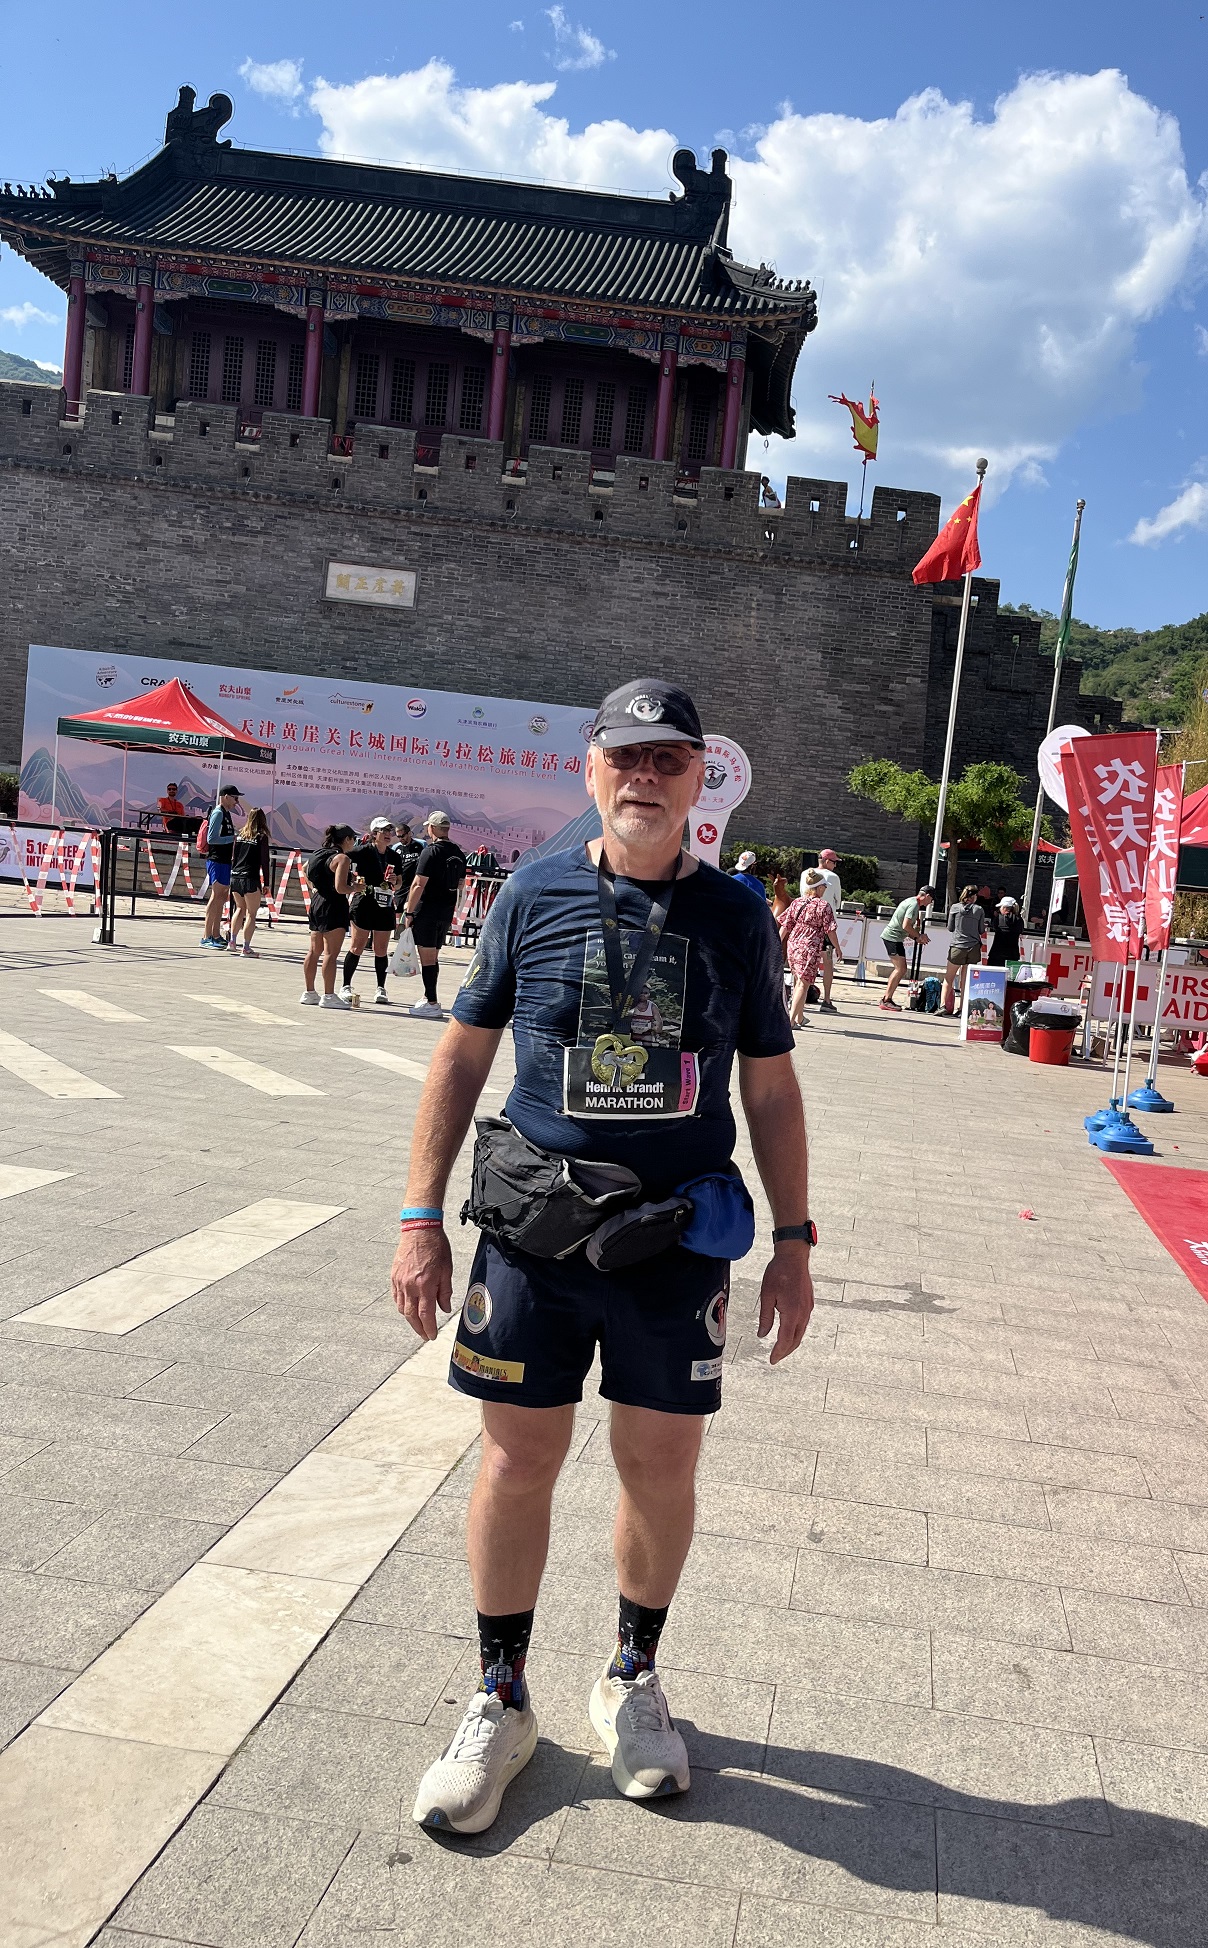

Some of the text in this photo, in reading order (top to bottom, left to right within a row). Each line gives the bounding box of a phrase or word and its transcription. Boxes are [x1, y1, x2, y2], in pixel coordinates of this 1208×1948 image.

[141, 677, 169, 687] CRA
[219, 684, 251, 695] 农夫山泉
[329, 699, 365, 707] culturestone
[168, 732, 210, 747] 农夫山泉
[237, 718, 583, 774] 天津黄崖关长城国际马拉松旅游活动
[264, 741, 557, 781] angyaguan Great Wall International Marathon Tourism Event
[596, 960, 606, 968] yo
[1164, 974, 1208, 998] FIRS
[1162, 997, 1208, 1021] AID
[626, 1081, 664, 1093] Brandt
[585, 1096, 664, 1109] MARATHON
[683, 1088, 691, 1105] Start
